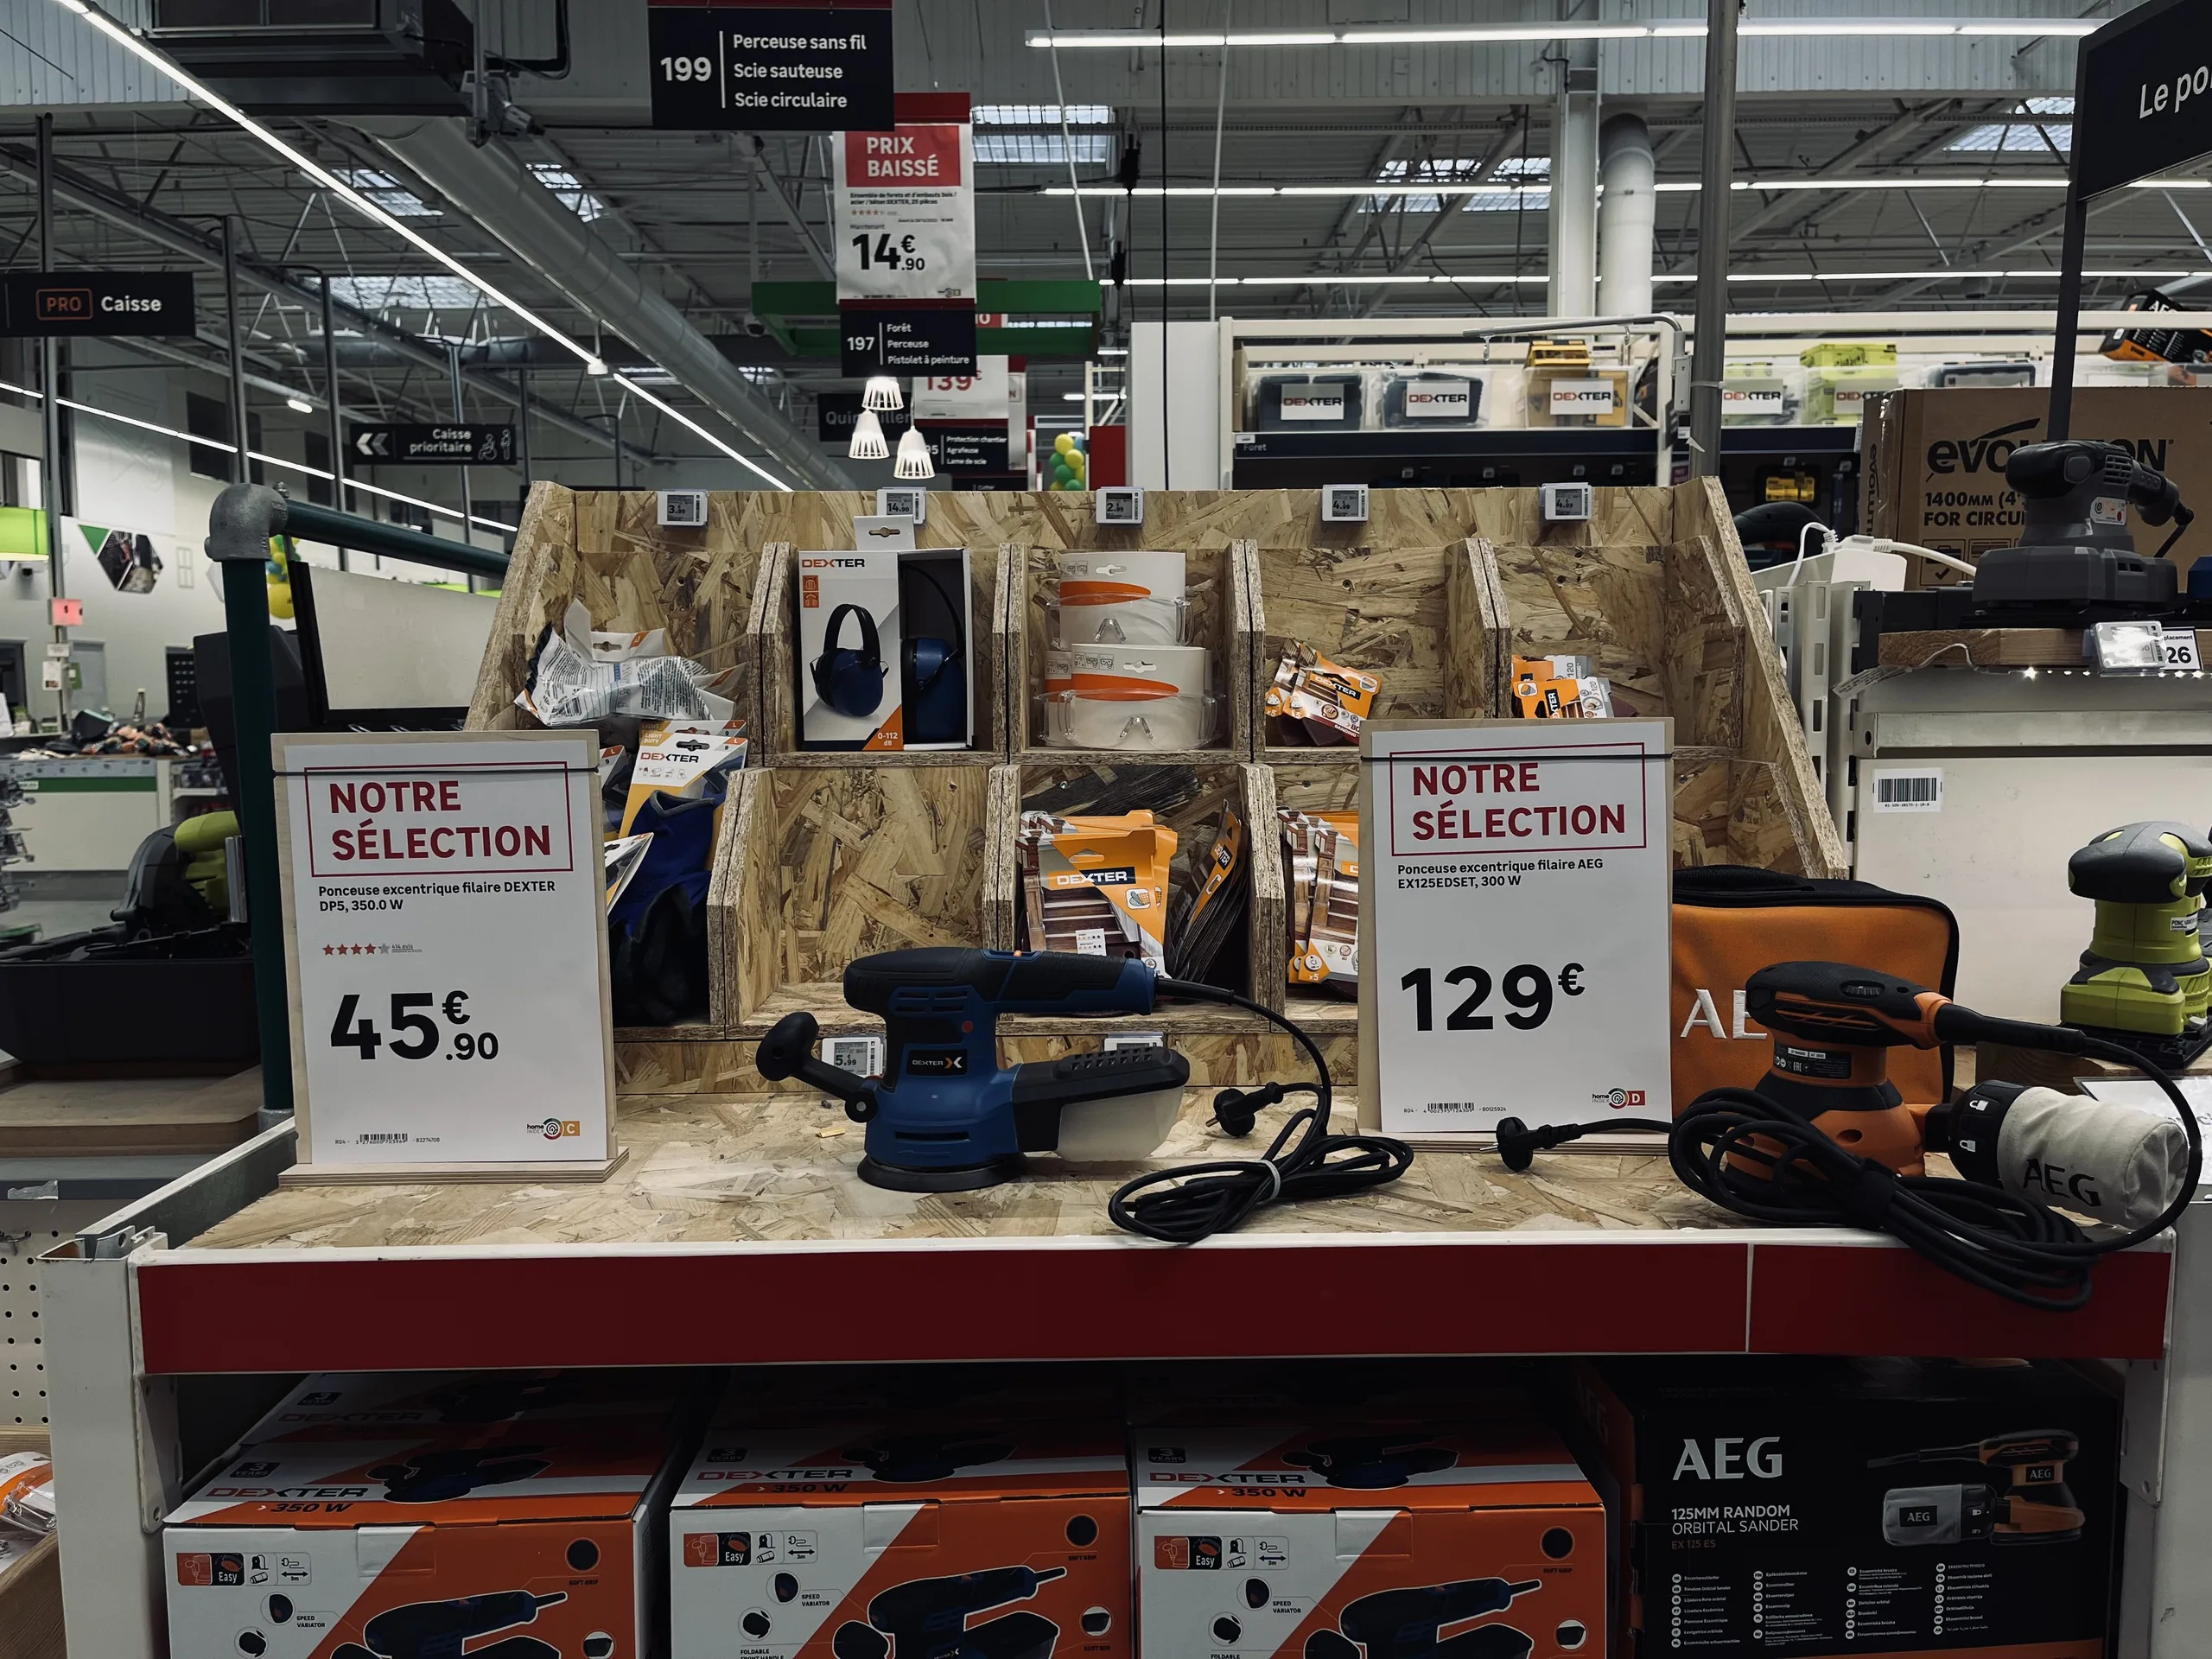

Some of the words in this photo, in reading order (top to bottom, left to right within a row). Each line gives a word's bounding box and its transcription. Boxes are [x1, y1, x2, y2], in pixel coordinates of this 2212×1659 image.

[733, 34, 807, 49] Perceuse
[810, 37, 847, 49] sans
[849, 35, 867, 50] fil
[660, 56, 712, 82] 199
[734, 62, 767, 78] Scie
[770, 64, 843, 79] sauteuse
[2139, 84, 2168, 119] Le
[2175, 67, 2212, 113] po
[734, 92, 768, 107] Scie
[771, 92, 848, 108] circulaire
[866, 137, 914, 155] PRIX
[868, 154, 939, 177] BAISSÉ
[46, 296, 82, 312] PRO
[100, 295, 162, 313] Caisse
[887, 323, 912, 334] Forêt
[848, 337, 874, 351] 197
[887, 340, 929, 348] Perceuse
[887, 355, 923, 365] Pistolet
[931, 356, 970, 365] peinture
[1283, 397, 1343, 407] DEXTER
[1408, 393, 1467, 404] DEXTER
[1553, 391, 1611, 402] DEXTER
[1723, 391, 1781, 400] DEXTER
[432, 429, 472, 441] Caisse
[409, 441, 472, 454] prioritaire
[1924, 512, 1961, 526] FOR
[802, 558, 865, 568] DEXTER
[2166, 646, 2191, 664] 26
[640, 753, 699, 763] DEXTER
[1413, 762, 1540, 795] NOTRE
[329, 780, 461, 813] NOTRE
[1413, 799, 1625, 841] SÉLECTION
[332, 818, 551, 861] SÉLECTION
[1398, 864, 1457, 875] Ponceuse
[1459, 861, 1535, 874] excentrique
[1537, 859, 1576, 871] filaire
[1578, 859, 1604, 869] AEG
[1057, 871, 1128, 886] DEXTER
[1398, 876, 1478, 889] EX125EDSET,
[1481, 875, 1505, 887] 300
[1508, 875, 1522, 886] W
[319, 885, 380, 897] Ponceuse
[382, 882, 460, 896] excentrique
[462, 881, 501, 893] filaire
[504, 880, 556, 893] DEXTER
[320, 900, 349, 913] DP5,
[351, 899, 387, 911] 350.0
[390, 899, 404, 910] W
[1631, 1094, 1641, 1104] D
[566, 1123, 575, 1135] C
[2022, 1159, 2101, 1207] AEG
[1672, 1436, 1783, 1480] AEG
[696, 1470, 853, 1480] DEXTER
[1149, 1472, 1306, 1484] DEXTER
[2031, 1469, 2051, 1479] AEG
[206, 1487, 369, 1497] DEXTER
[772, 1484, 817, 1493] 350
[823, 1484, 849, 1492] W
[1231, 1488, 1280, 1497] 350
[1284, 1488, 1307, 1497] W
[270, 1503, 321, 1513] 350
[325, 1503, 353, 1512] W
[1672, 1507, 1719, 1520] 125MM
[1724, 1505, 1790, 1518] RANDOM
[1907, 1512, 1930, 1522] AEG
[1673, 1521, 1735, 1535] ORBITAL
[1739, 1519, 1799, 1533] SANDER
[1672, 1541, 1684, 1549] EX
[1687, 1540, 1701, 1548] 125
[1704, 1539, 1716, 1548] ES
[725, 1552, 744, 1563] Easy
[1196, 1555, 1215, 1567] Easy
[219, 1572, 238, 1583] Easy
